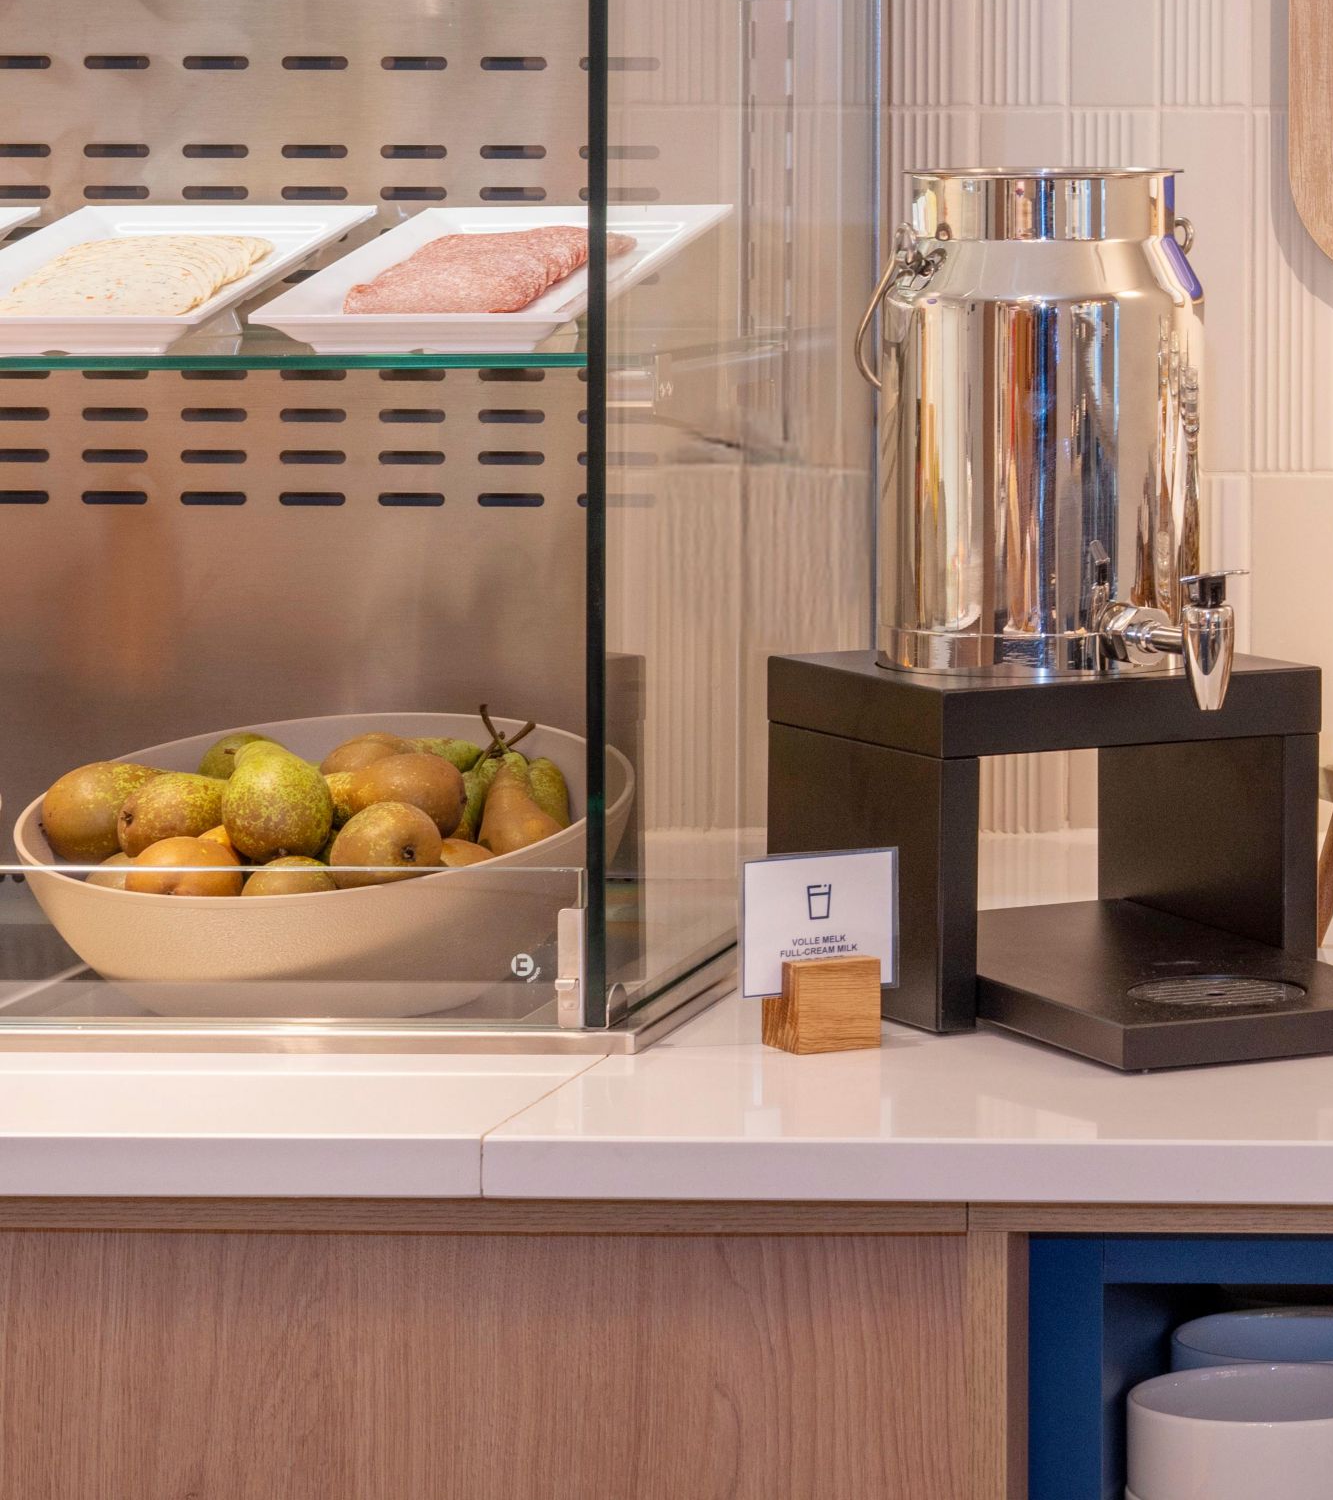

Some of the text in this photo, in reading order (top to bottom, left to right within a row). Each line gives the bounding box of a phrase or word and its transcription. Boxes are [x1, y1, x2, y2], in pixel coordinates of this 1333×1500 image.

[792, 934, 846, 946] VOLLE MELK
[780, 943, 858, 957] FULL-CREAM MILK
